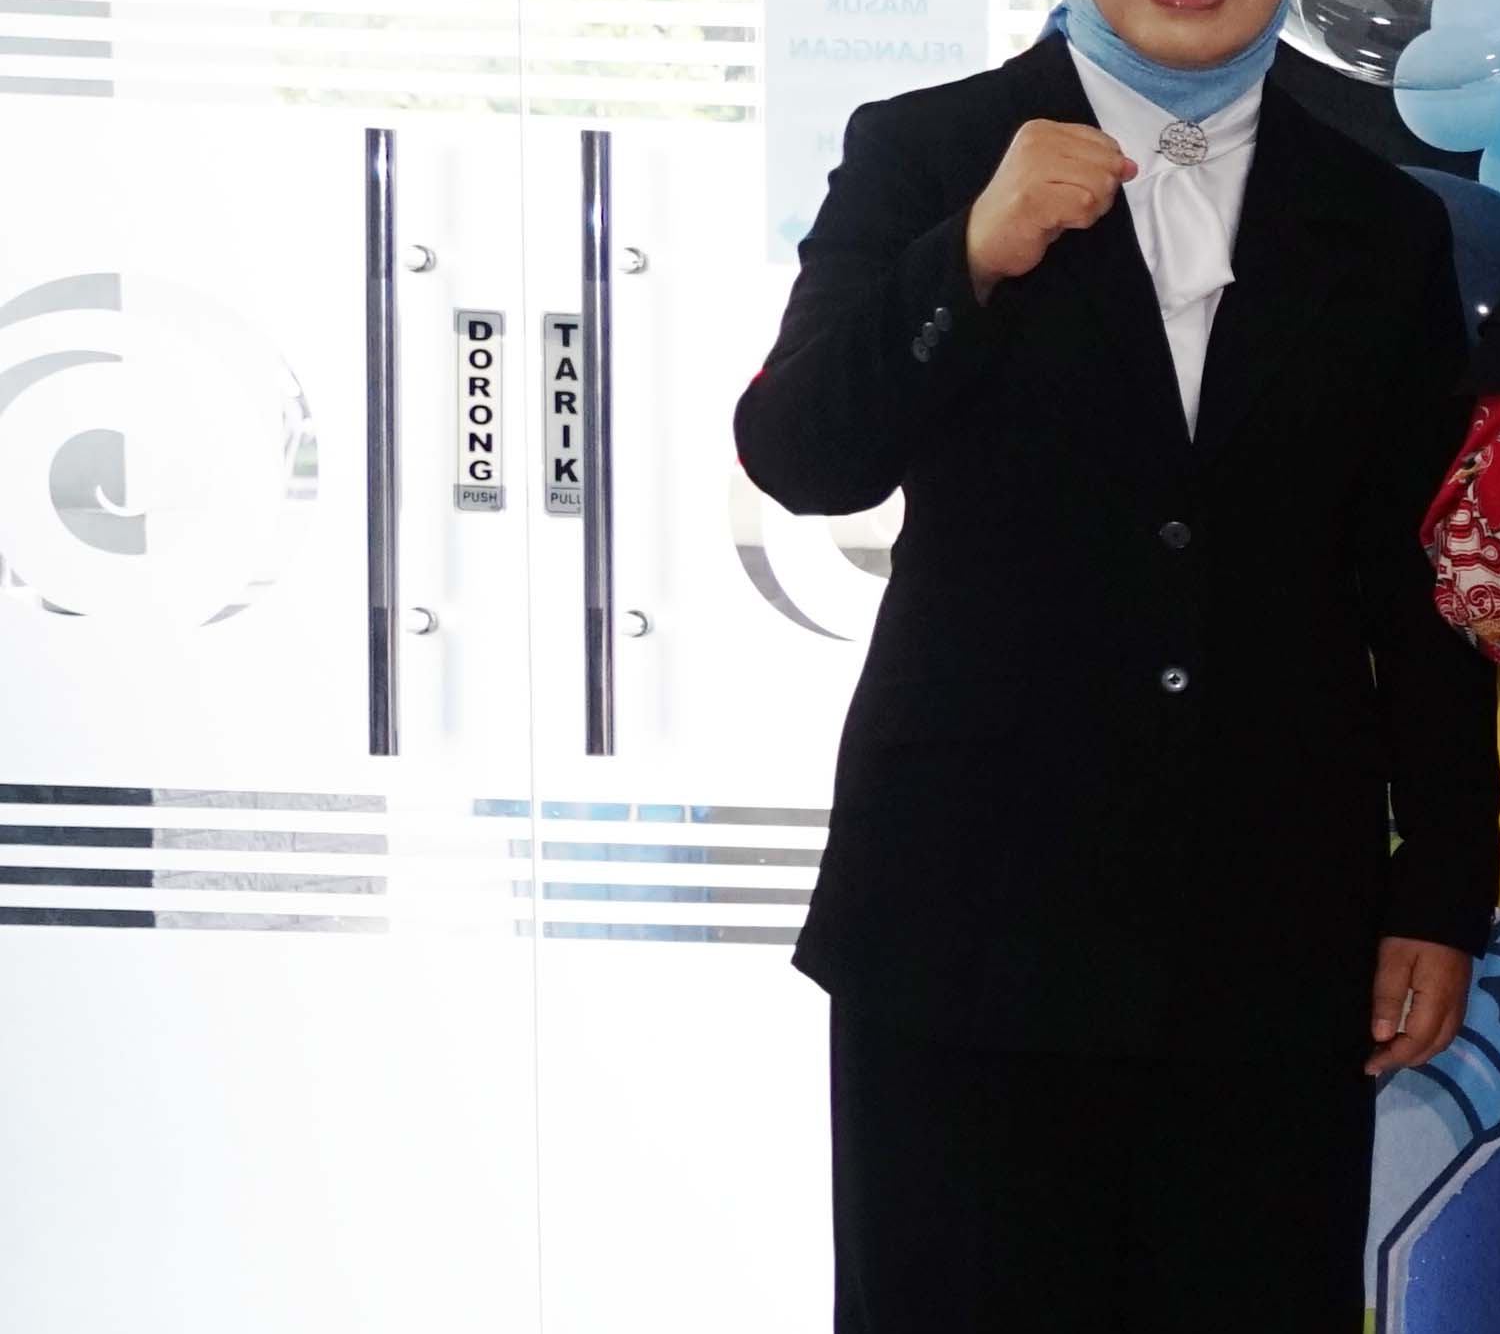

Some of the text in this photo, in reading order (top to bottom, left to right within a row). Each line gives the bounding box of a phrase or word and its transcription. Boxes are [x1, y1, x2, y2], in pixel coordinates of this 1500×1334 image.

[468, 320, 494, 482] DORONG
[553, 323, 579, 483] TARIK
[463, 491, 498, 503] PUSH
